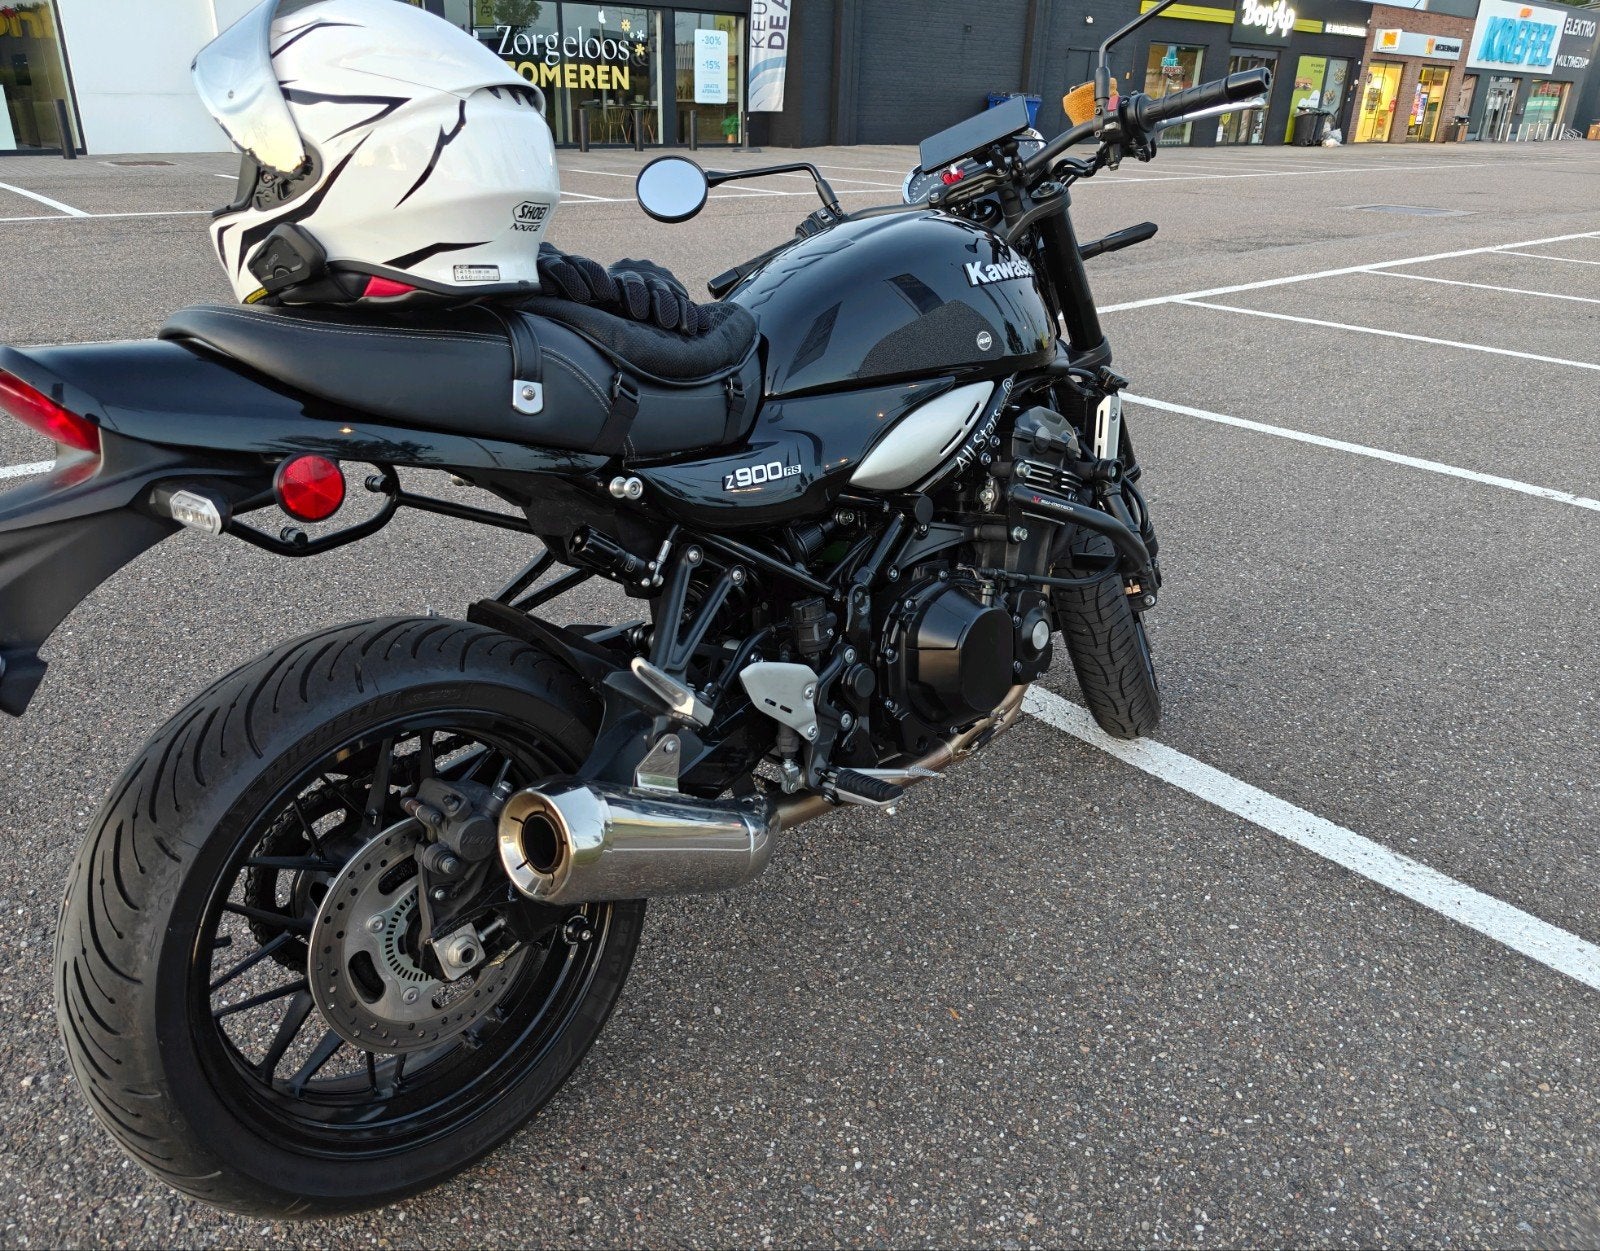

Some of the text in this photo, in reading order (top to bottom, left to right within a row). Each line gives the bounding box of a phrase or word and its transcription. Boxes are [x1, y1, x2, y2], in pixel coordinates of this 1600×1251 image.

[1563, 17, 1597, 38] ELEKTRO
[496, 25, 631, 66] Zorgeloos
[701, 35, 722, 46] -30%
[702, 60, 721, 71] -15%
[956, 445, 977, 473] All
[725, 461, 782, 489] Z900
